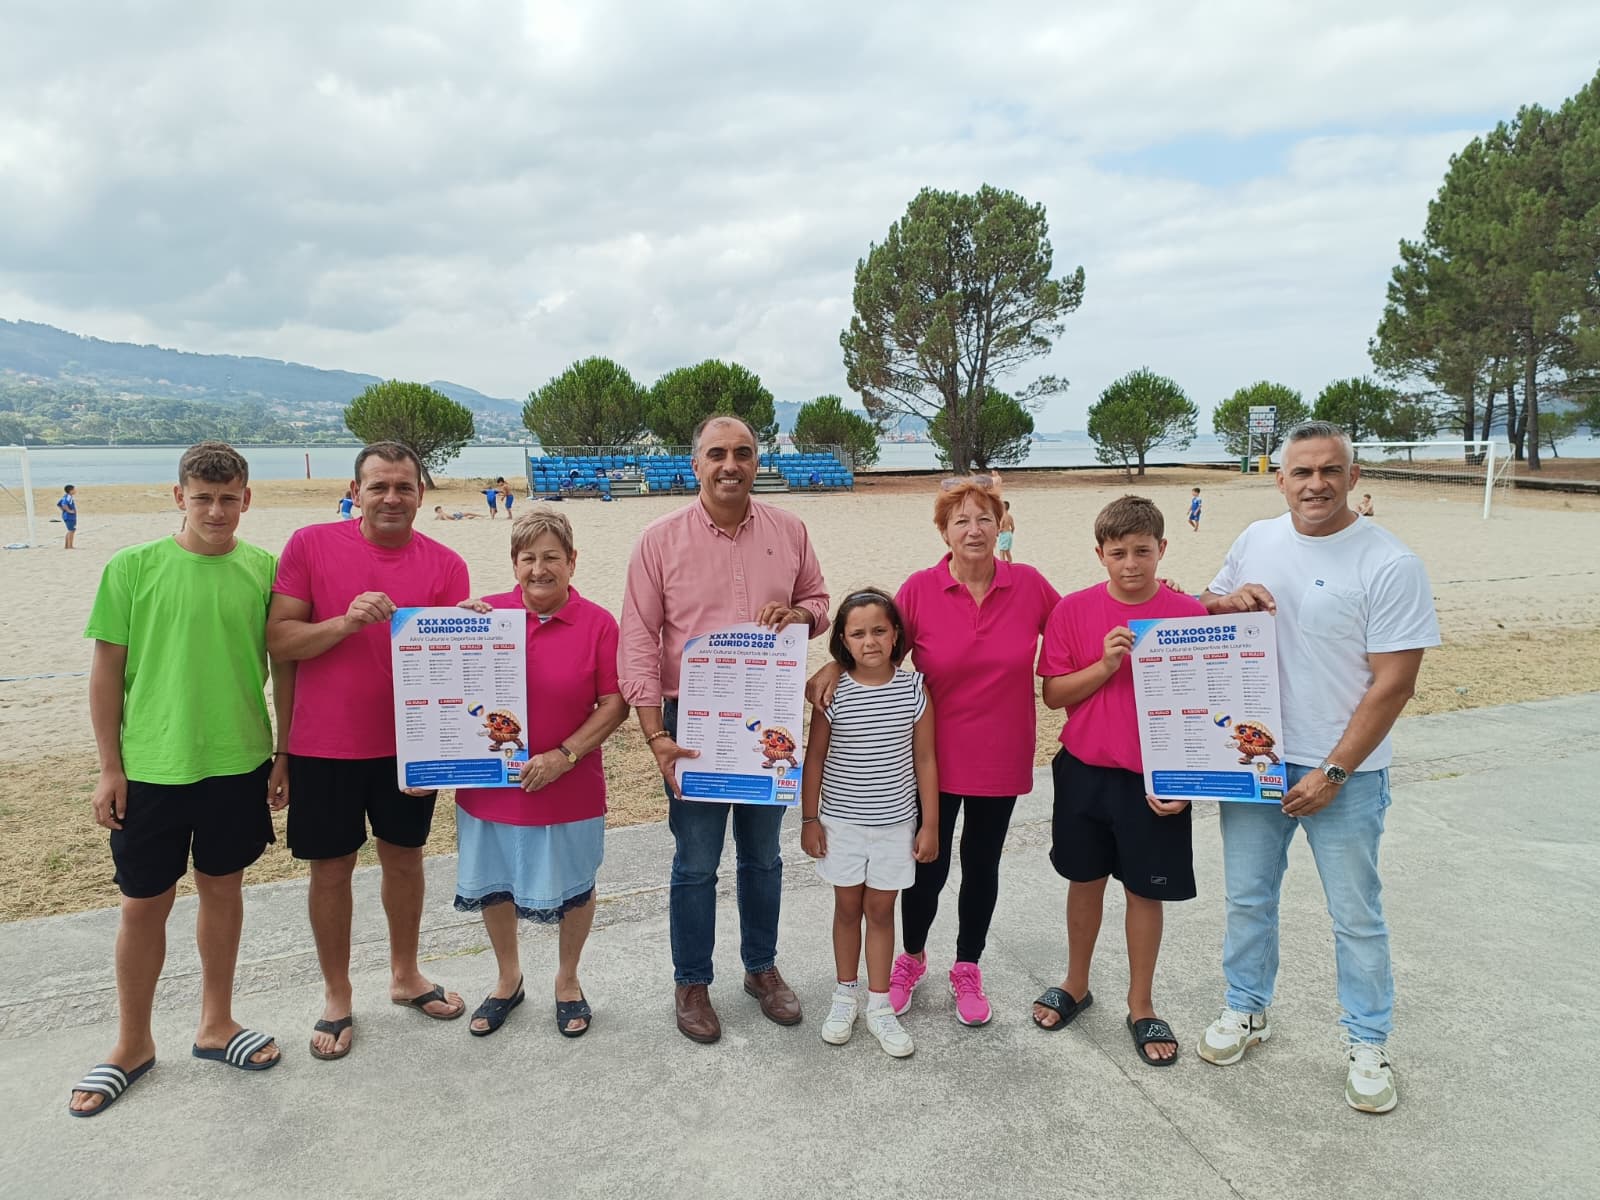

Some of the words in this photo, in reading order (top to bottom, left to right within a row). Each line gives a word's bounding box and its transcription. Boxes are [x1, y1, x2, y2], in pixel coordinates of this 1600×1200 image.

[417, 618, 439, 626] XXX
[1182, 628, 1221, 636] XOGOS
[730, 633, 764, 641] XOGOS
[1158, 636, 1206, 645] LOURIDO
